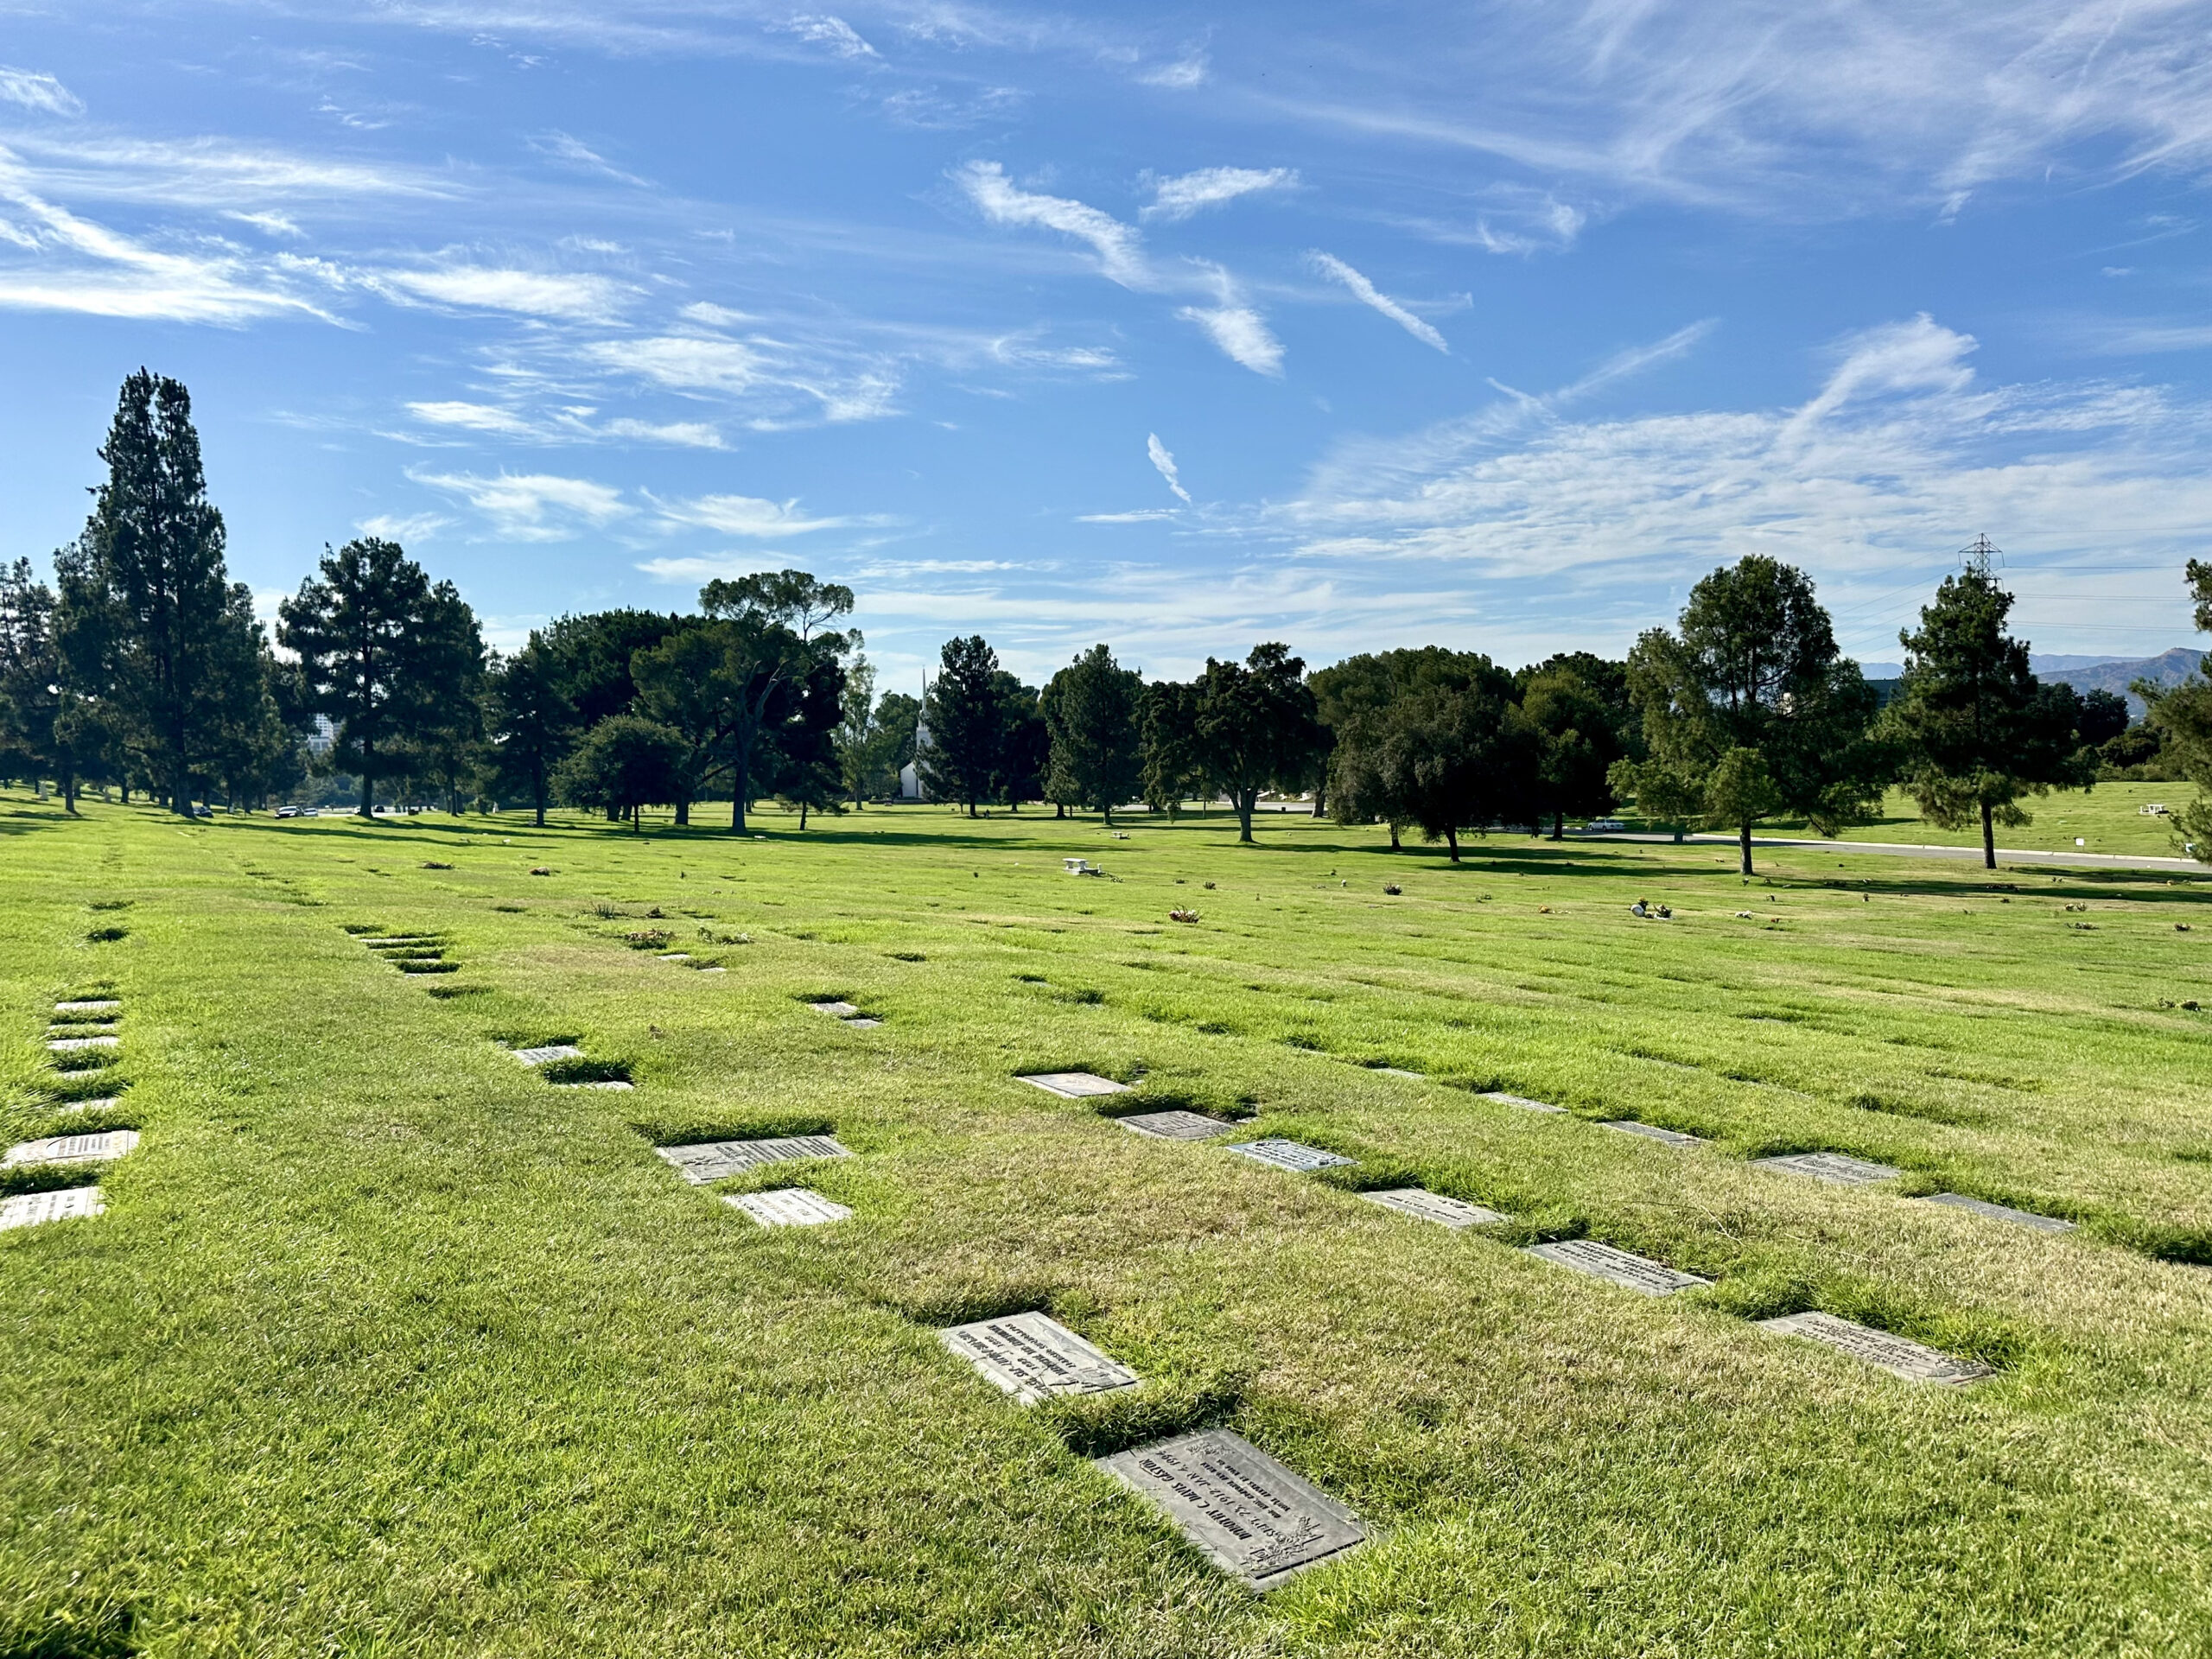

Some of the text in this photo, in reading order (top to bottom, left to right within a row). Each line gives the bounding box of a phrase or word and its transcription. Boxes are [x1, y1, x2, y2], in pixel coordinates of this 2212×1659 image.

[1139, 1458, 1174, 1482] GASTON
[1171, 1482, 1202, 1503] DAVIS
[1205, 1510, 1253, 1541] DOROTHY
